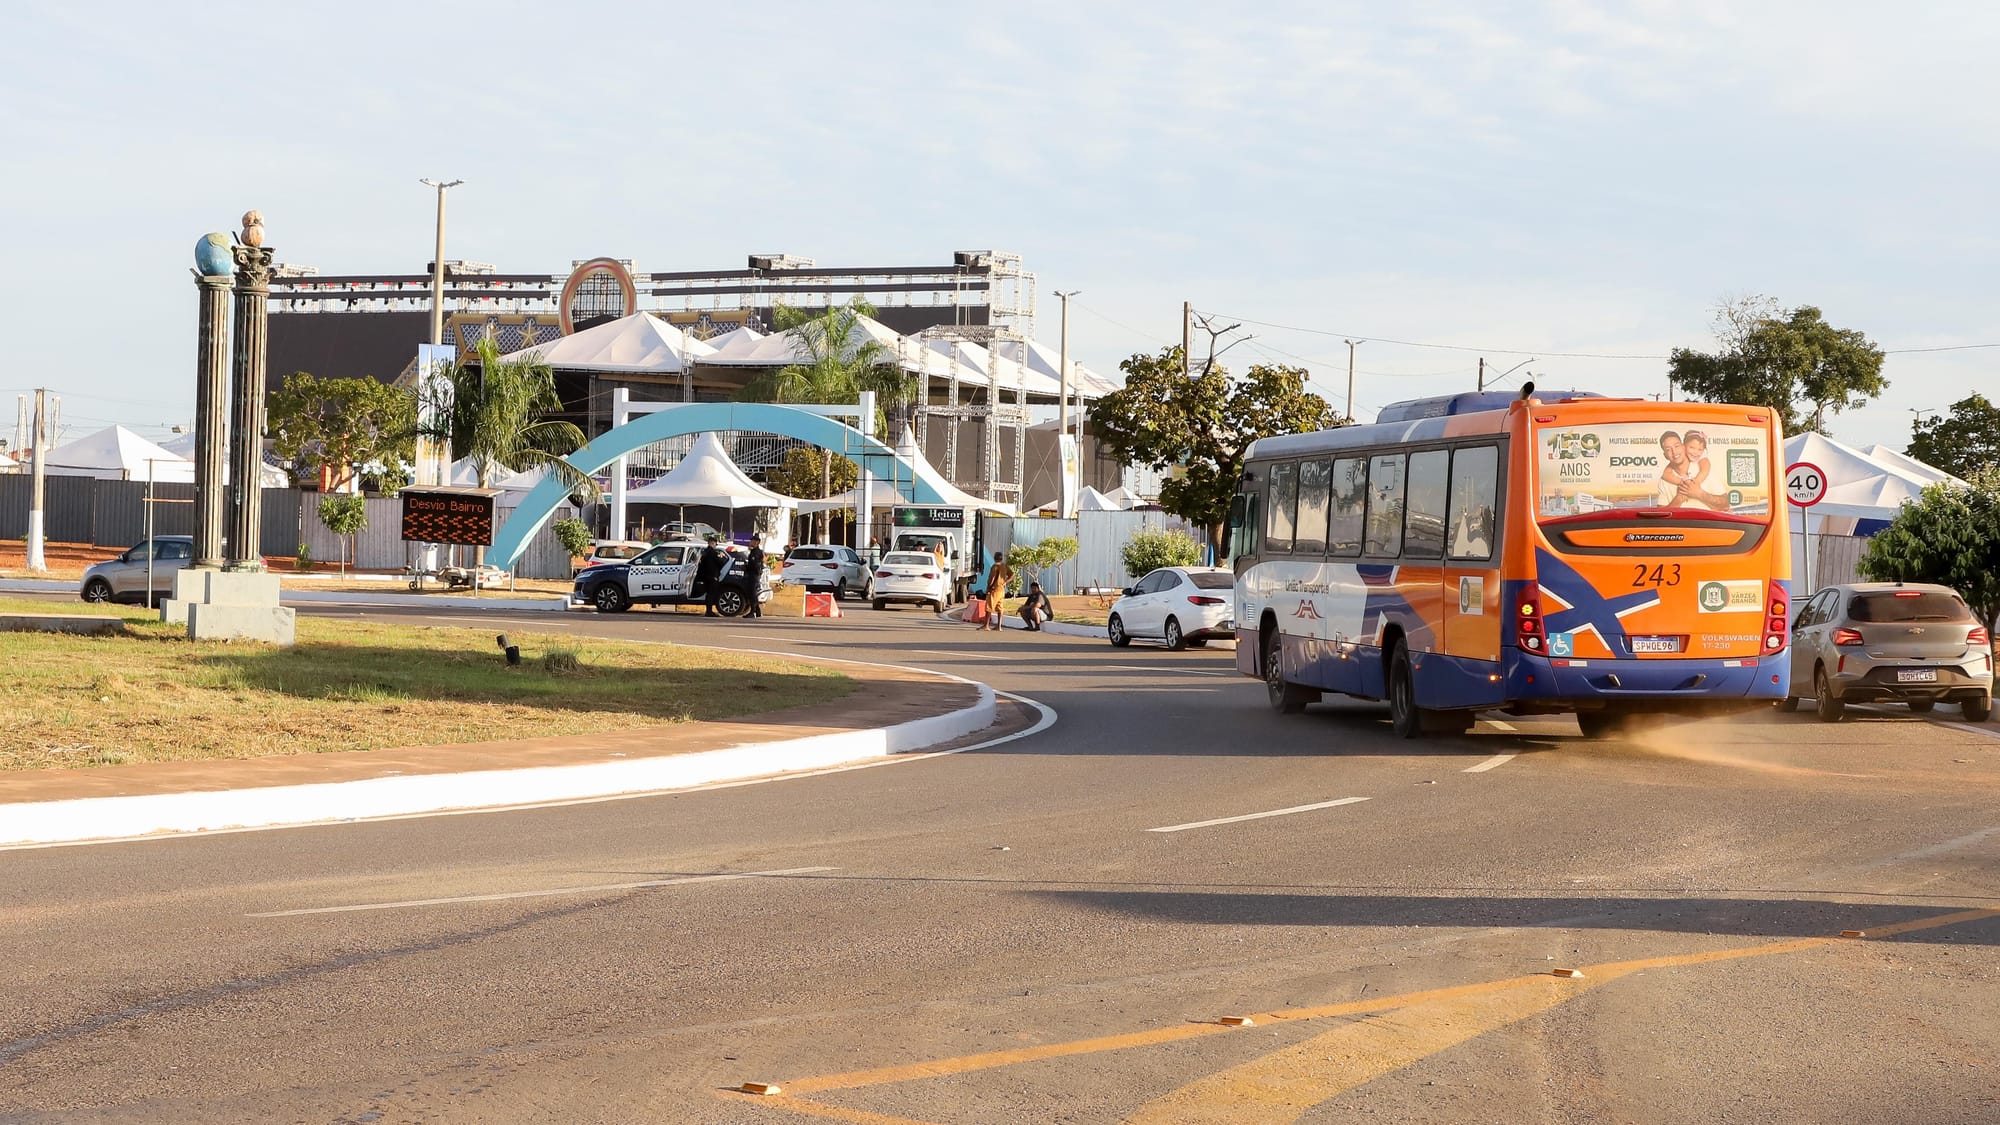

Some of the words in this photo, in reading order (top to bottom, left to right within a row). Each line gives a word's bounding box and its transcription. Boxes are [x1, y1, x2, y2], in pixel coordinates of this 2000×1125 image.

[1609, 456, 1658, 467] EXPOVG
[1560, 462, 1591, 476] ANOS
[1788, 475, 1819, 490] 40
[409, 498, 446, 511] Desvio
[450, 500, 484, 513] Bairro
[929, 509, 962, 518] Heitor
[1632, 563, 1681, 587] 243
[641, 581, 683, 591] POLÍC
[1702, 634, 1761, 642] VOLKSWAGEN
